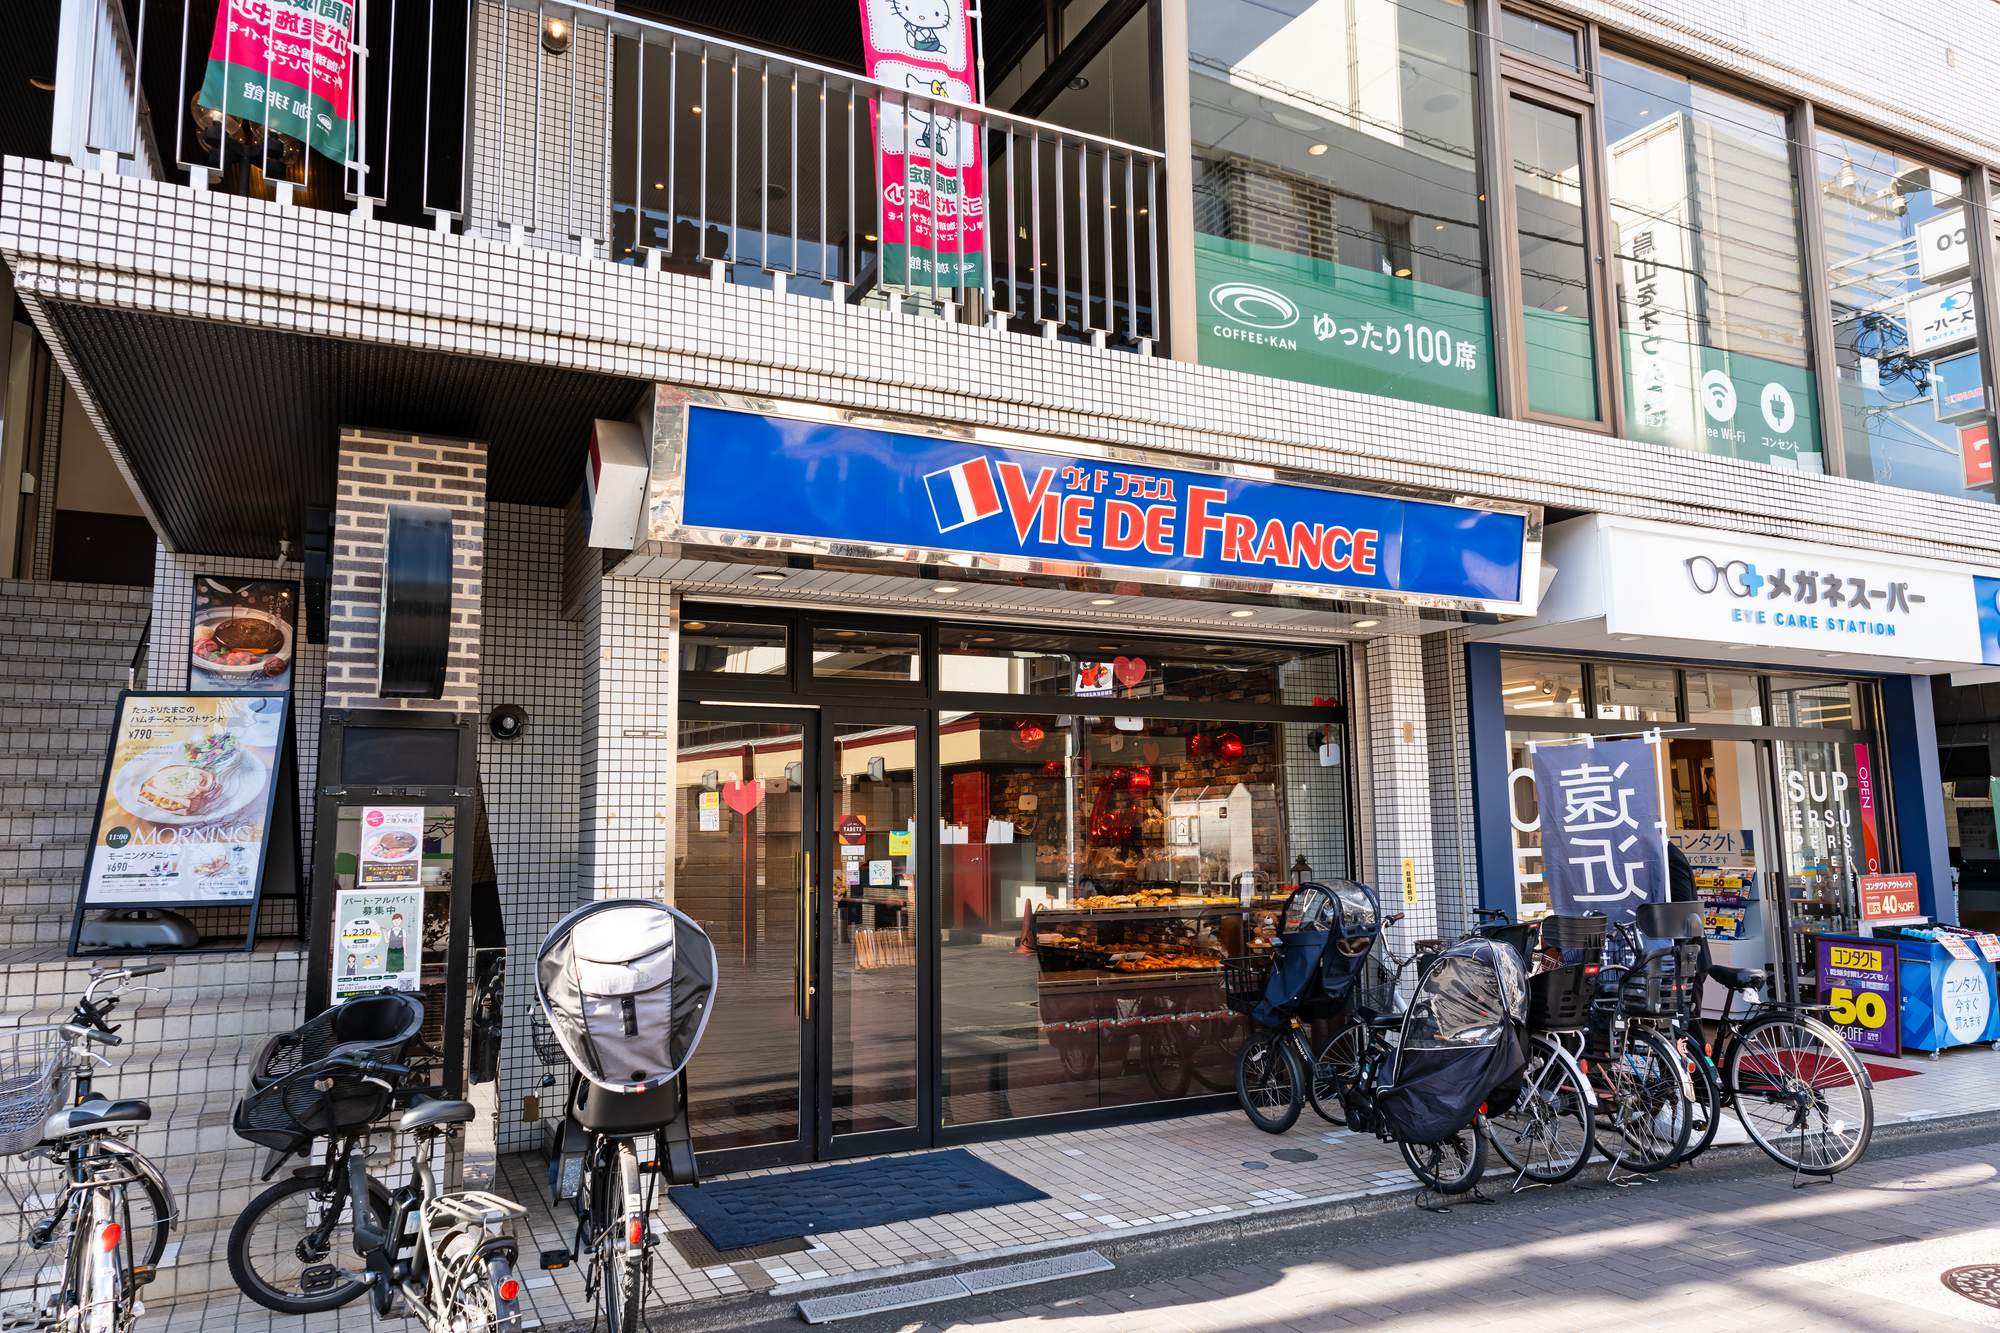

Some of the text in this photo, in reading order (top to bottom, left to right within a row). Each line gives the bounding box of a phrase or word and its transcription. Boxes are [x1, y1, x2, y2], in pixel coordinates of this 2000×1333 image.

[1313, 312, 1477, 371] ゆったり100席
[1698, 424, 1746, 443] Free Wi-Fi
[1761, 436, 1800, 452] コンセント
[1103, 498, 1177, 556] DE
[1183, 485, 1378, 576] FRANCE
[1768, 568, 1926, 614] メガネスーパー
[1732, 608, 1896, 636] EYE CARE STATION
[132, 706, 195, 714] たっぷりたまごの
[129, 729, 152, 740] ¥790
[1788, 771, 1849, 802] SUP
[1859, 766, 1871, 808] OPEN
[1792, 809, 1850, 828] ERSU
[132, 826, 252, 845] MORNING
[1669, 833, 1735, 852] コンタクト
[1795, 834, 1852, 850] PERS
[1713, 879, 1725, 887] 50
[1865, 880, 1913, 890] コンタクトアウトレット
[363, 906, 396, 915] 募集中
[1705, 917, 1717, 926] 50
[1834, 949, 1878, 968] コンタクト
[1946, 975, 1983, 994] コンタクト
[1829, 987, 1887, 1028] 50
[1955, 997, 1979, 1013] 今すぐ
[1955, 1014, 1981, 1030] 買えます
[1833, 1024, 1864, 1042] %OFF
